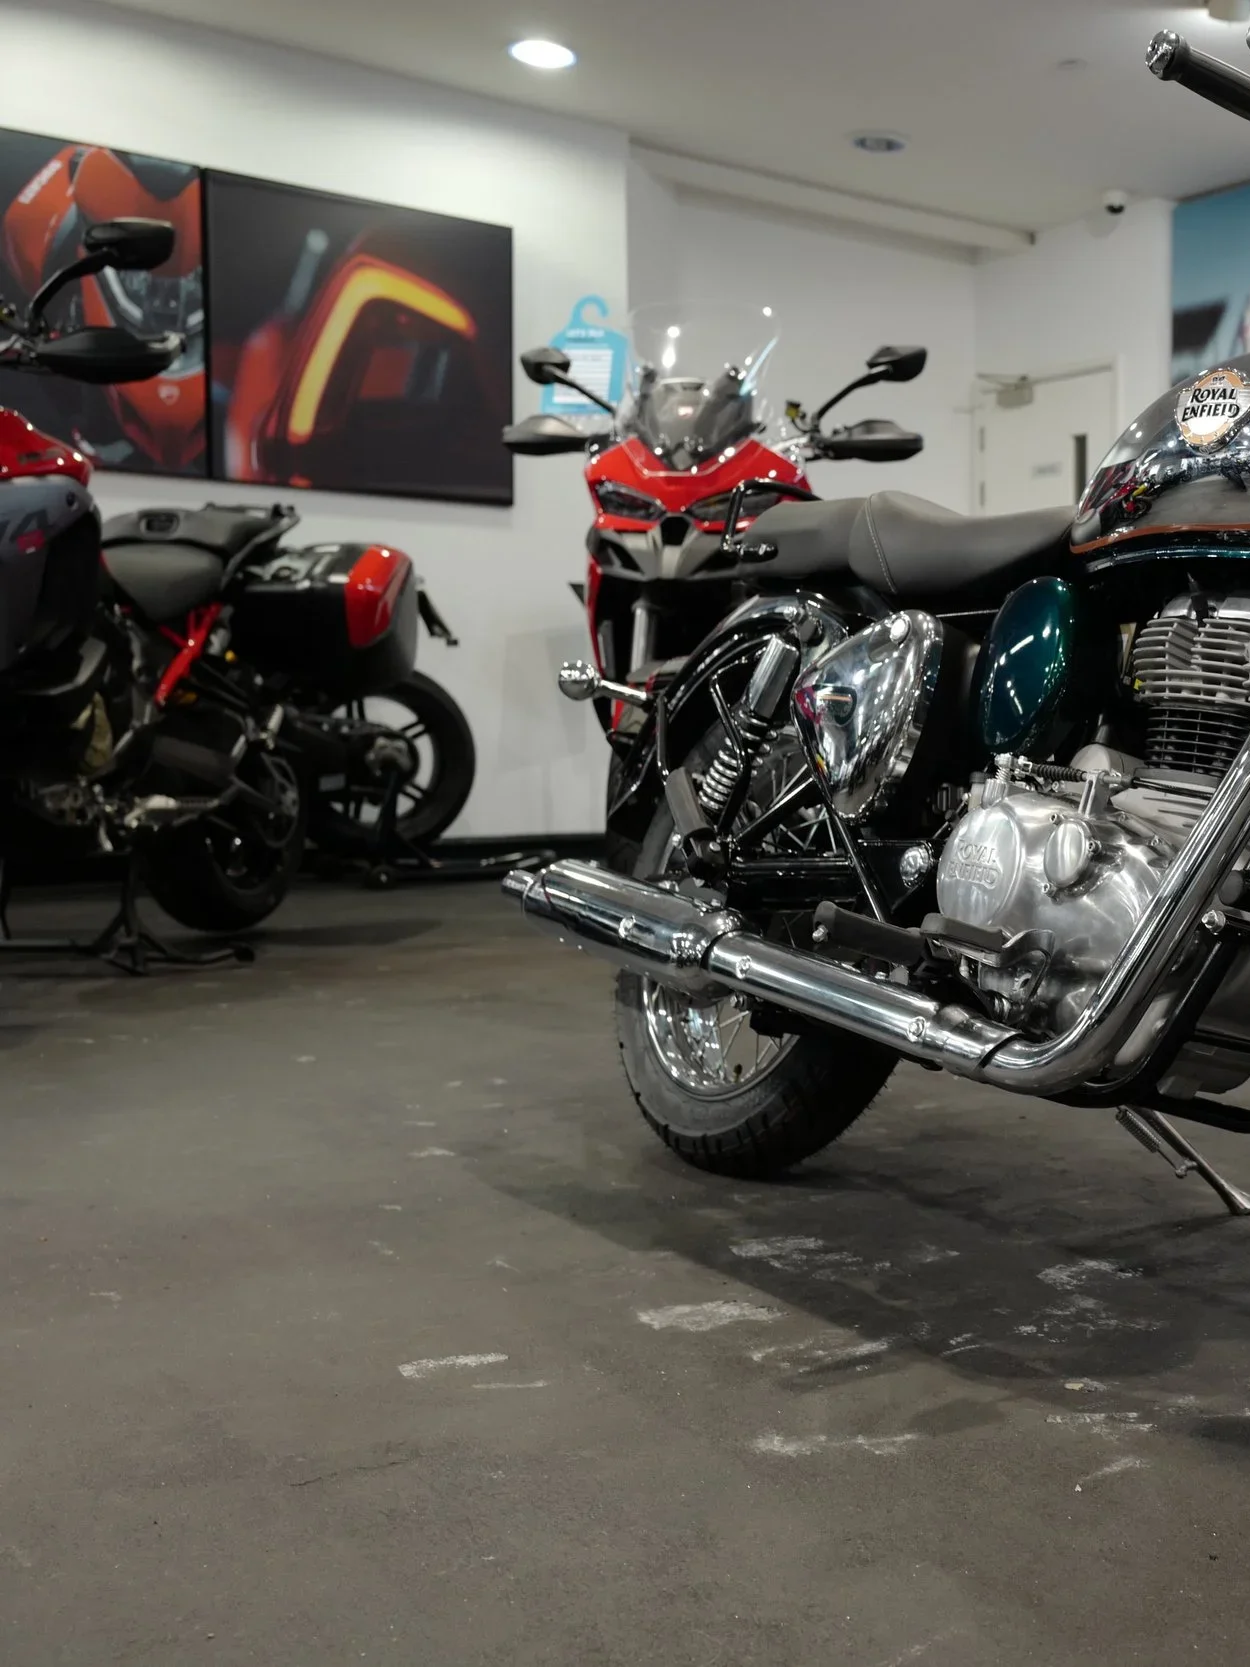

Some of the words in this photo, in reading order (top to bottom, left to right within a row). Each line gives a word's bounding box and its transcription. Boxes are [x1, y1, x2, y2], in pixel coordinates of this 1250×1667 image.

[1190, 387, 1238, 404] ROYAL
[1181, 403, 1241, 423] ENFIELD
[957, 838, 997, 864] ROYAL
[947, 860, 1000, 886] ENFIELD
